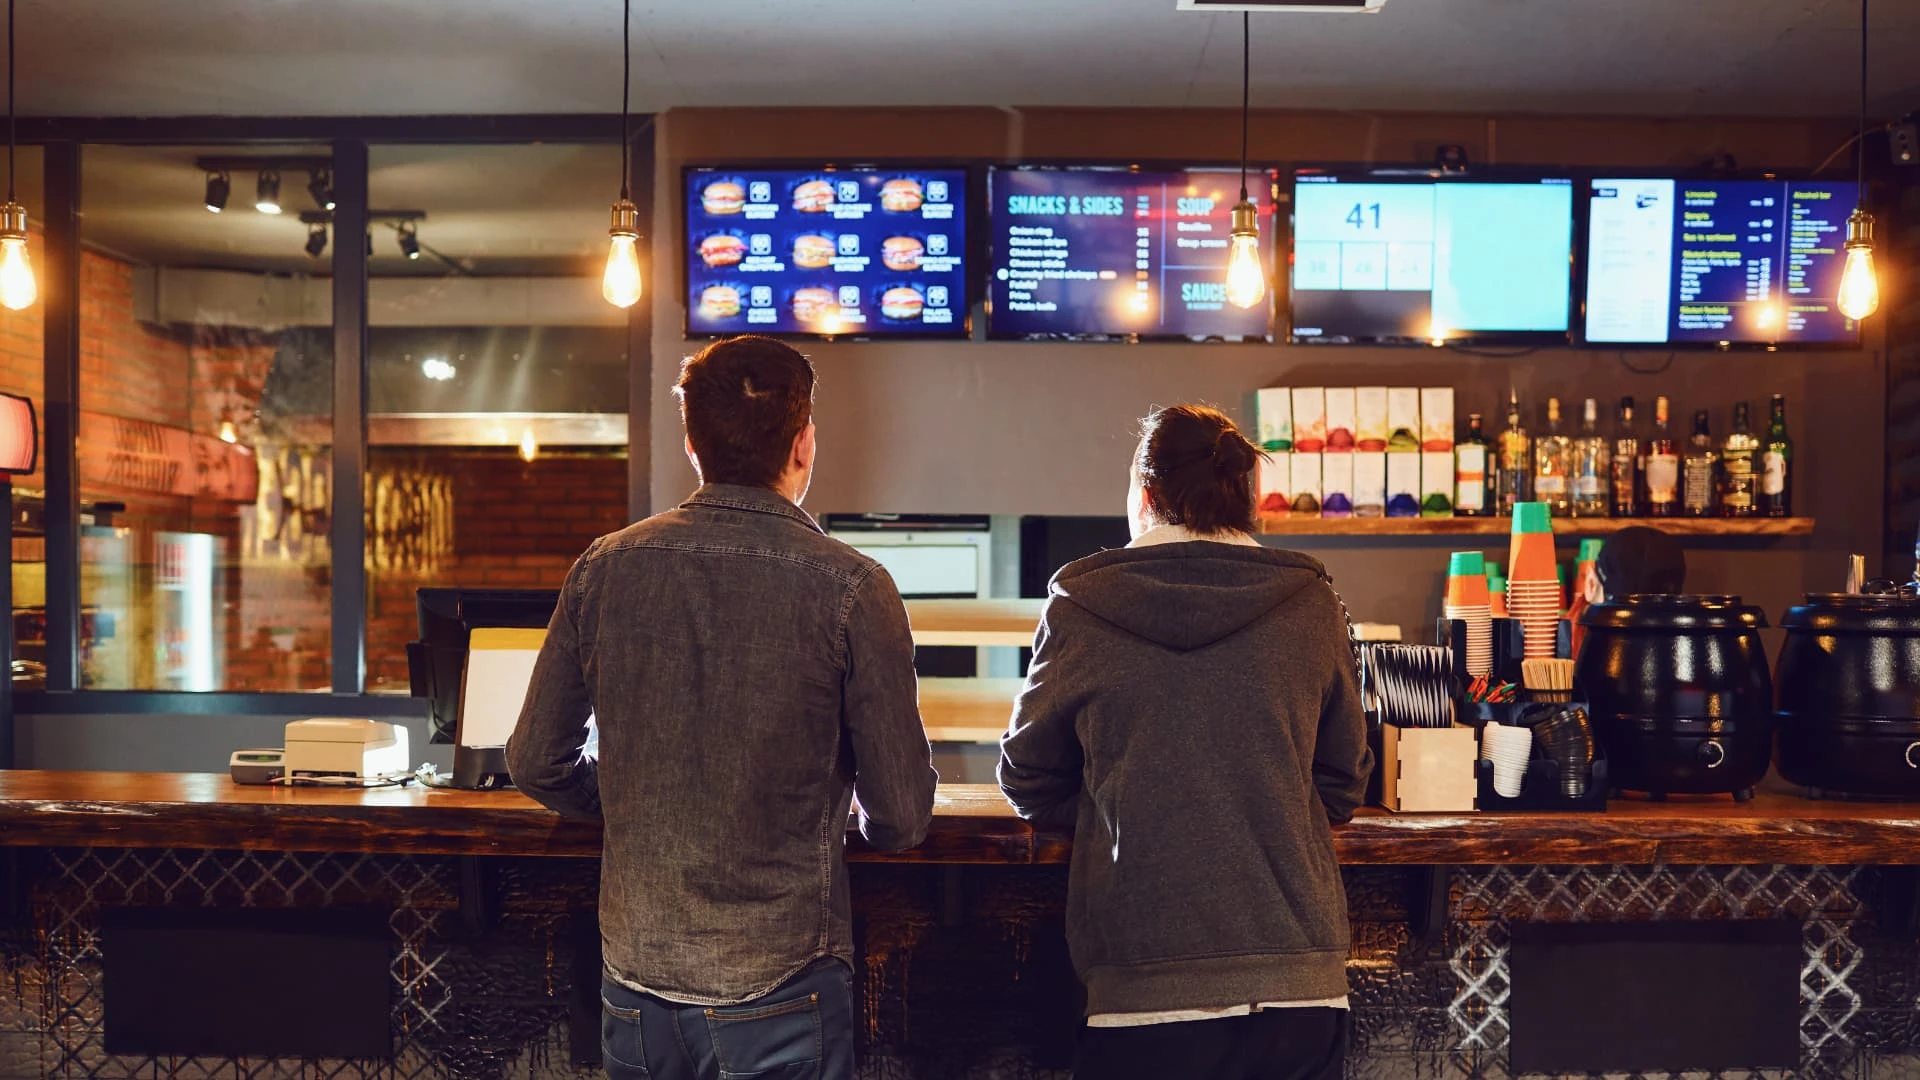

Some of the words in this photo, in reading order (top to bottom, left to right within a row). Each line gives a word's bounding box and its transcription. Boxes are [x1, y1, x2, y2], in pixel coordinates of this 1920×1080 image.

[1008, 195, 1066, 215] SNACKS
[1069, 195, 1081, 215] &
[1082, 195, 1124, 215] SIDES
[1177, 197, 1215, 216] SOUP
[1346, 202, 1381, 229] 41
